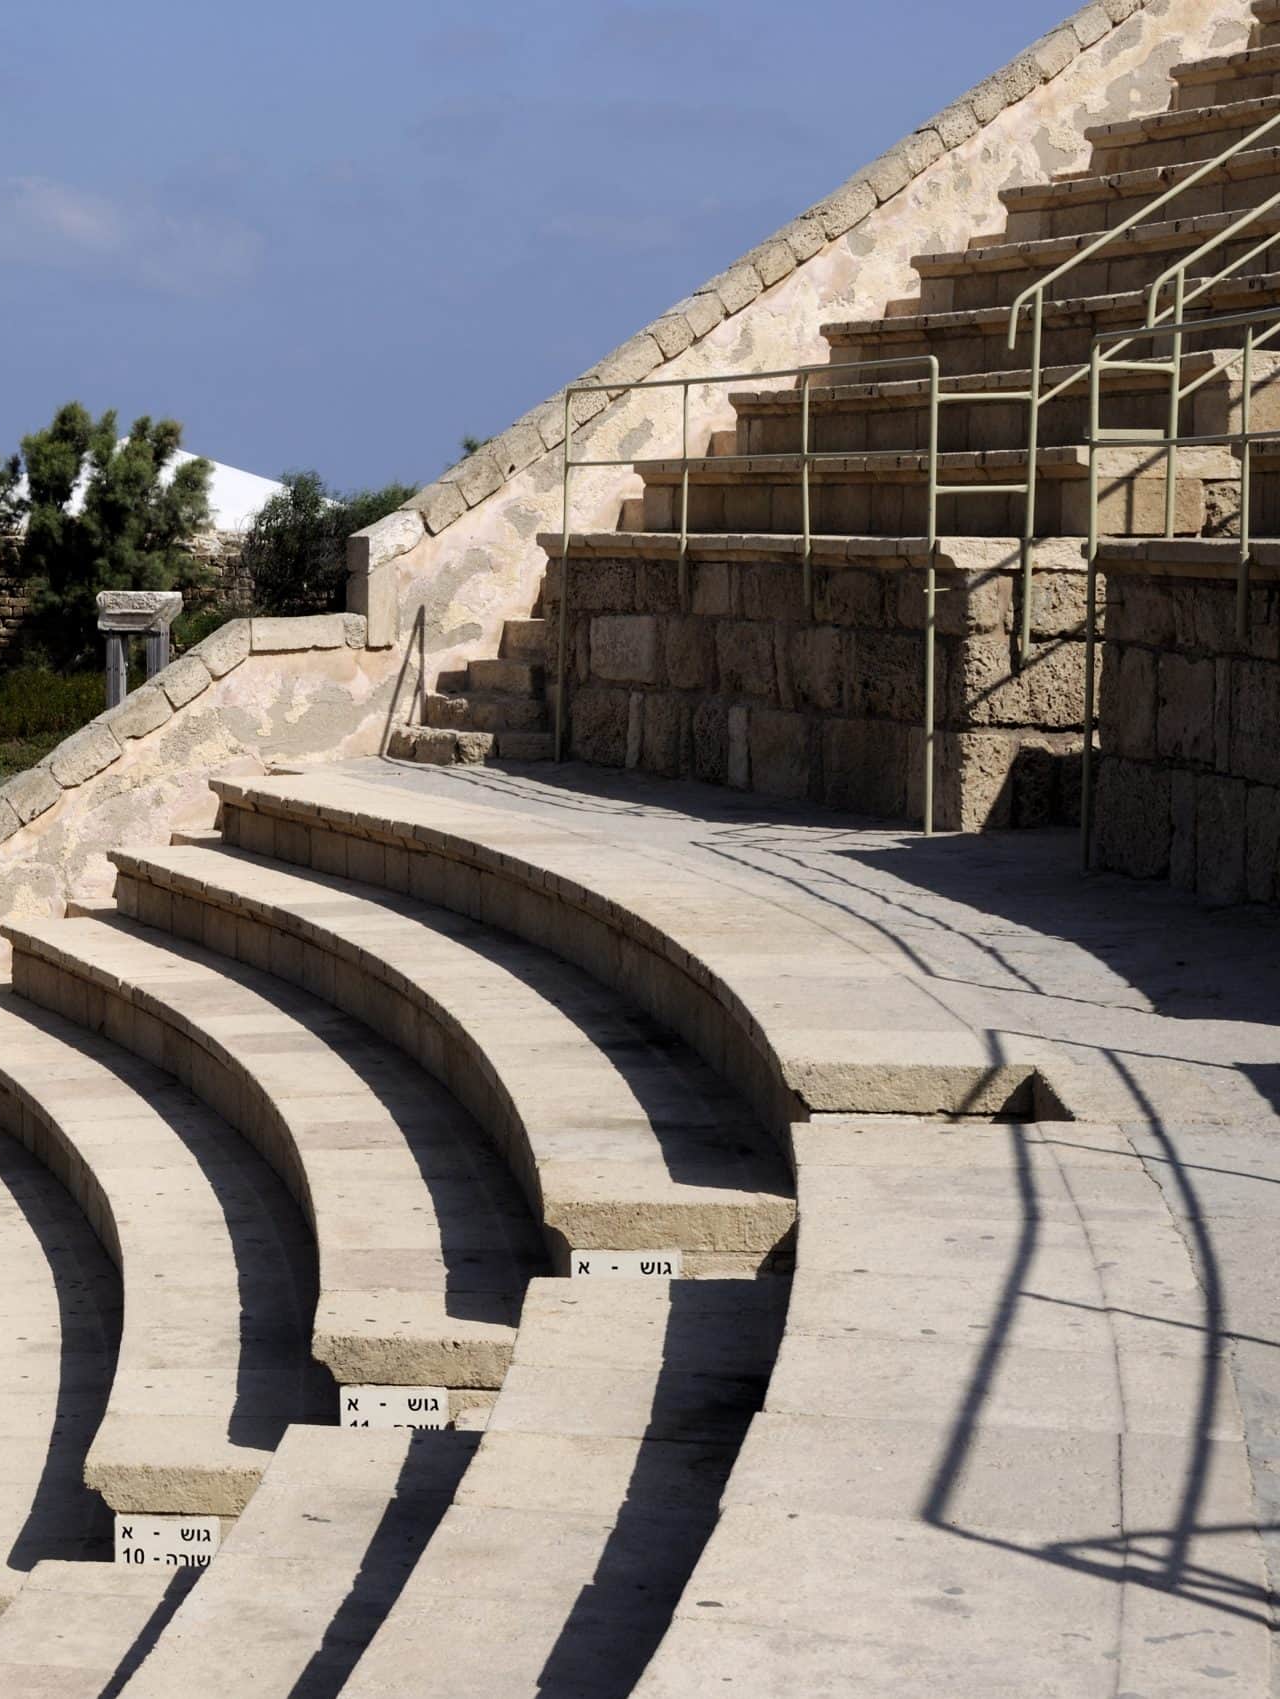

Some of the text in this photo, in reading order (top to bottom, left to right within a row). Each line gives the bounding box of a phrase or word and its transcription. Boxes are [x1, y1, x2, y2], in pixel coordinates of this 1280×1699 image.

[578, 1261, 590, 1275] א
[640, 1261, 672, 1275] גוש
[347, 1398, 359, 1412] א
[407, 1398, 439, 1412] גוש
[121, 1526, 133, 1540] א
[180, 1528, 211, 1542] גוש
[122, 1547, 145, 1565] 10
[166, 1553, 212, 1567] שורה
